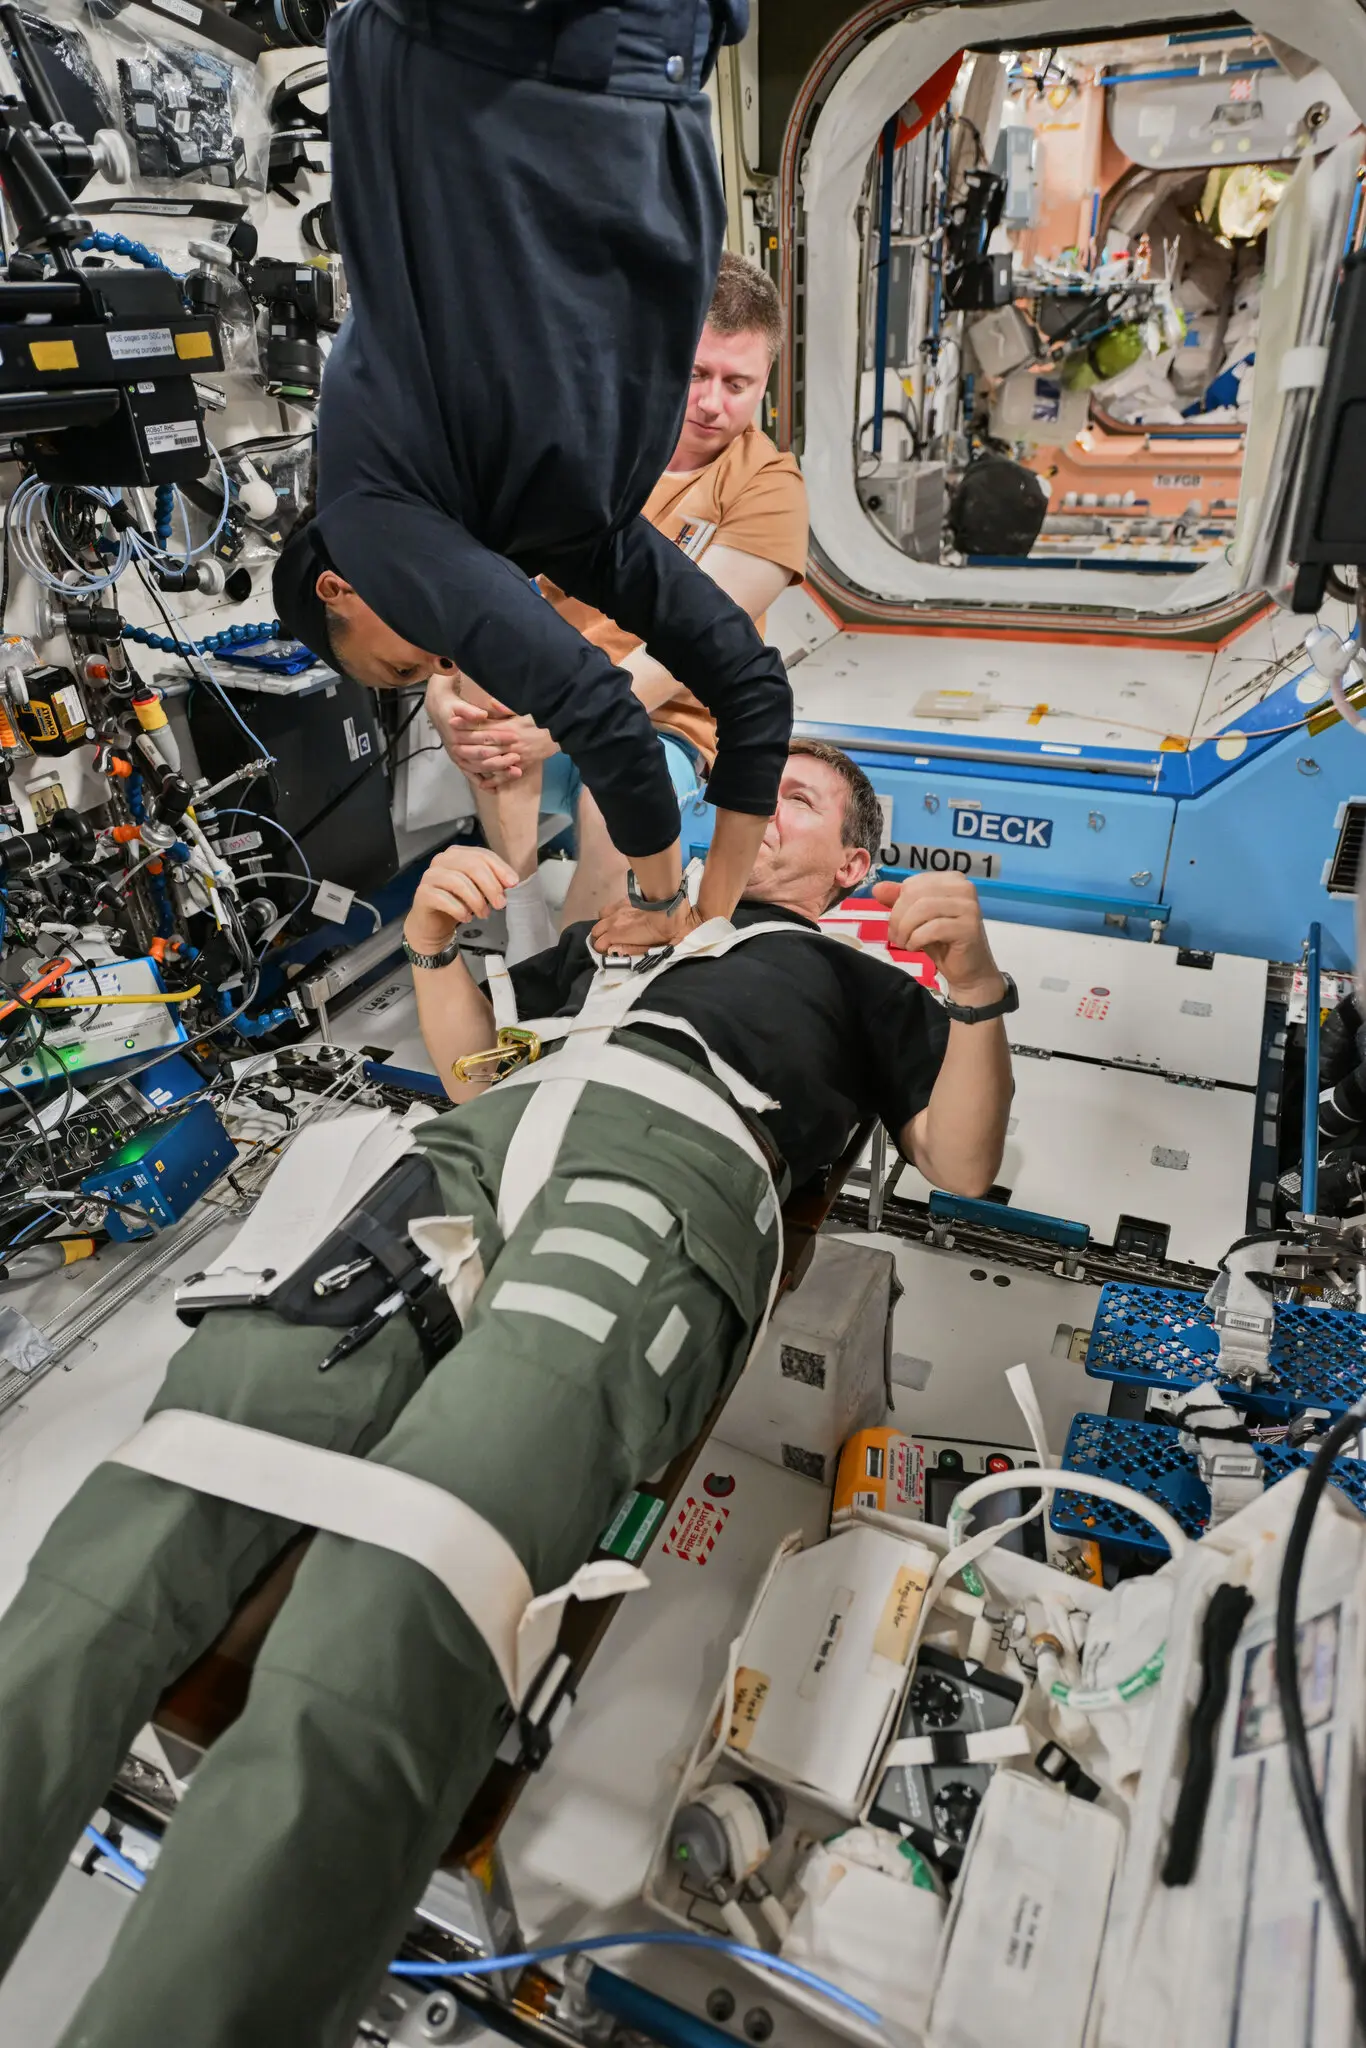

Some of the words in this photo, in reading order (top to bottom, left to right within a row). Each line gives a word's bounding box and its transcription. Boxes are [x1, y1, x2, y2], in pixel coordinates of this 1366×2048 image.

[956, 811, 1050, 847] DECK
[910, 846, 972, 874] NOD
[982, 855, 993, 878] 1
[684, 1532, 698, 1552] FIRE
[693, 1510, 709, 1532] PORT
